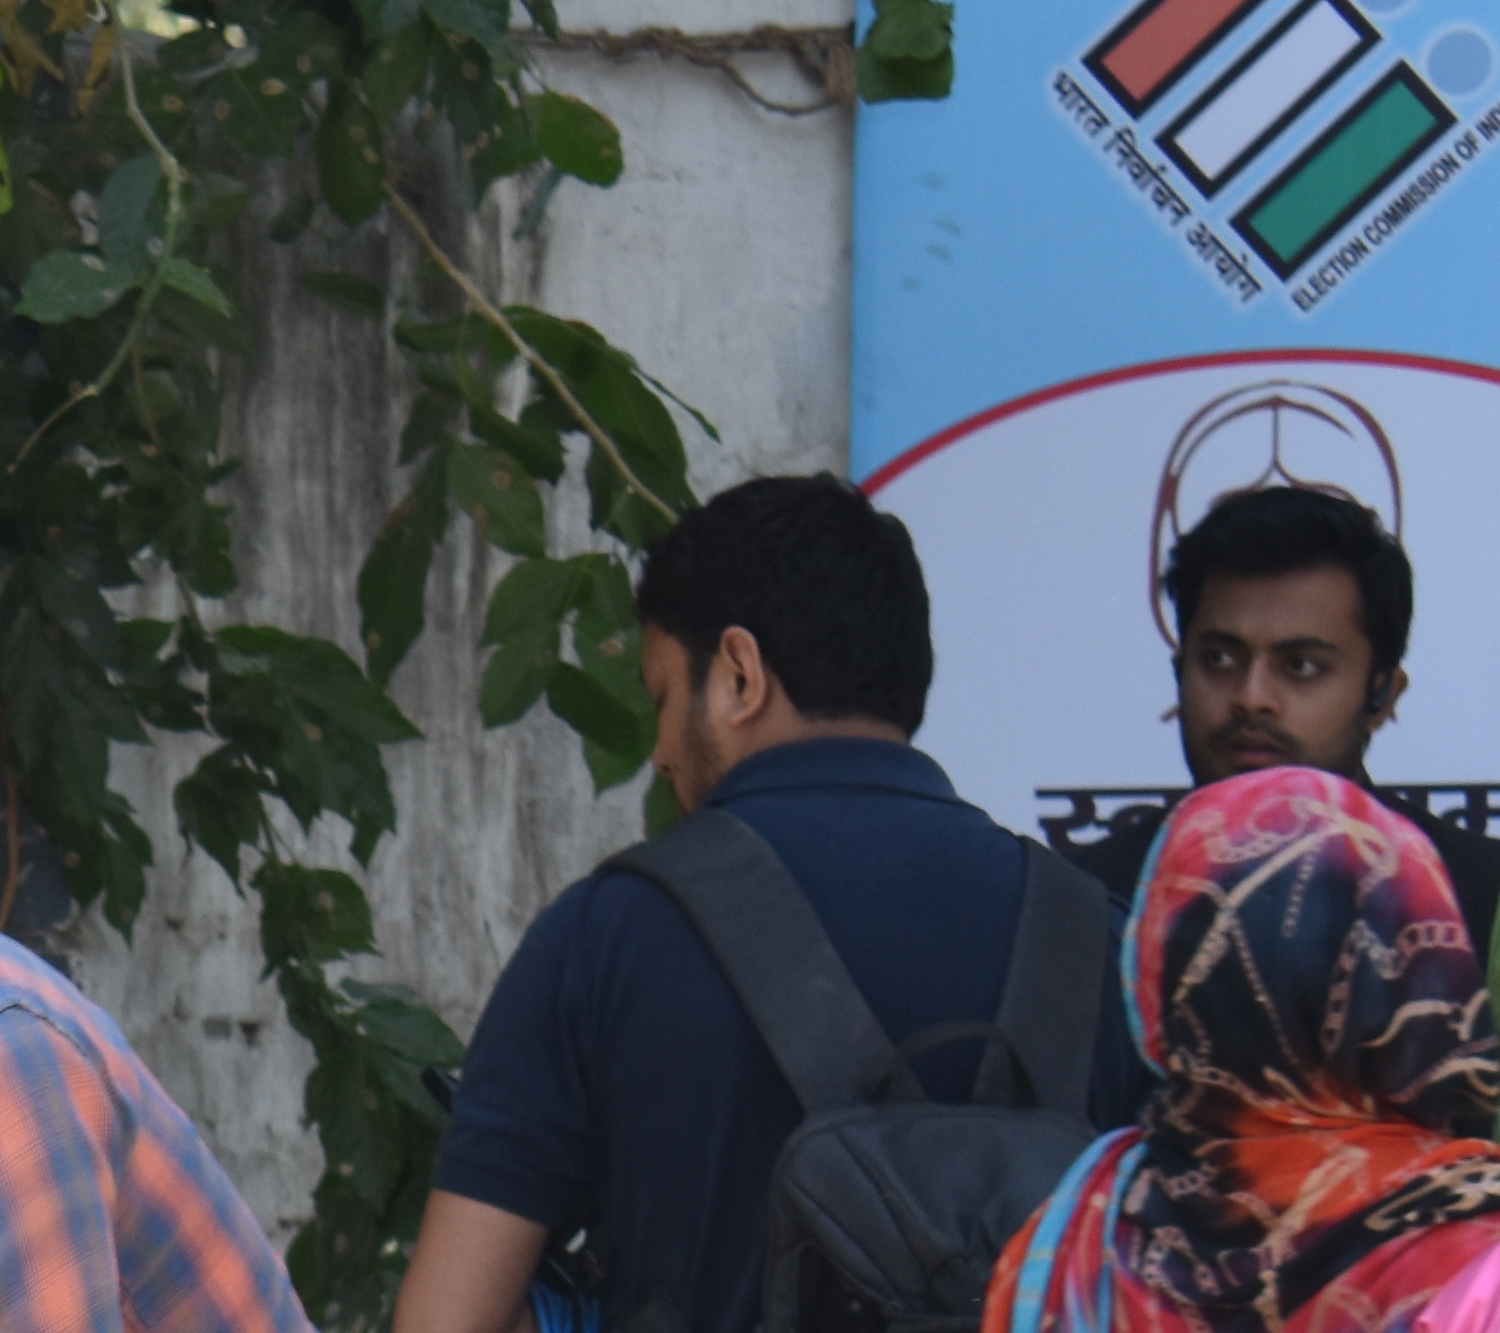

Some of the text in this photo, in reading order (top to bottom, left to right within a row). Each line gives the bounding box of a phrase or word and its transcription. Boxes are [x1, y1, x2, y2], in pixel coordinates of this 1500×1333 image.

[1054, 72, 1110, 138] भारत
[1186, 222, 1263, 303] आयोग
[1291, 236, 1370, 313] ELECTION
[1362, 151, 1462, 246] COMMISSION
[1454, 129, 1481, 162] OF
